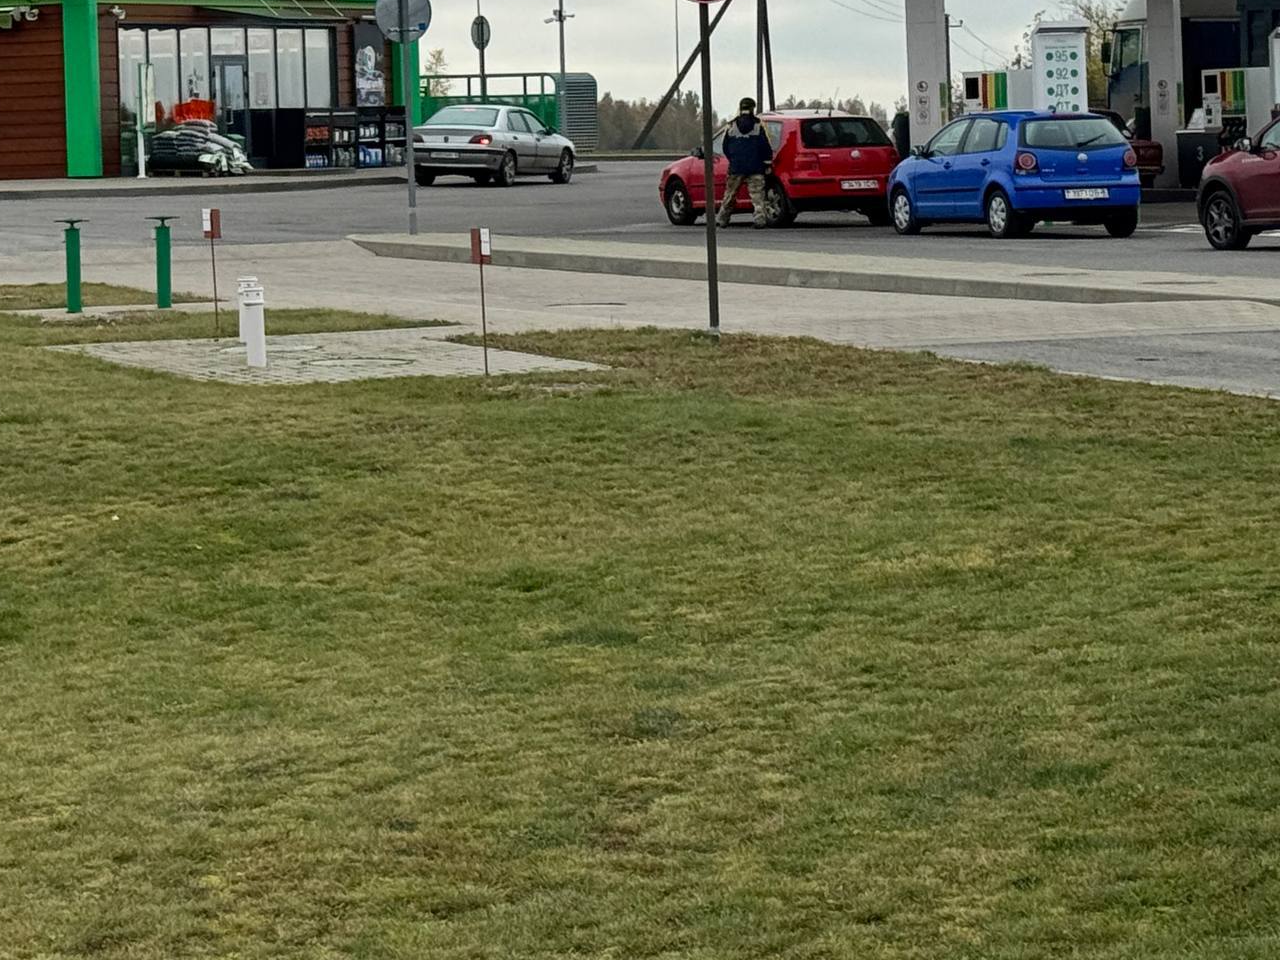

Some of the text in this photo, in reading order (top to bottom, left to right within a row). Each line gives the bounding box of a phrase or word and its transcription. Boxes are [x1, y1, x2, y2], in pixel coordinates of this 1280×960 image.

[1055, 50, 1068, 62] 95
[1055, 68, 1069, 80] 92
[1055, 84, 1069, 97] ДТ
[1196, 146, 1204, 160] 3
